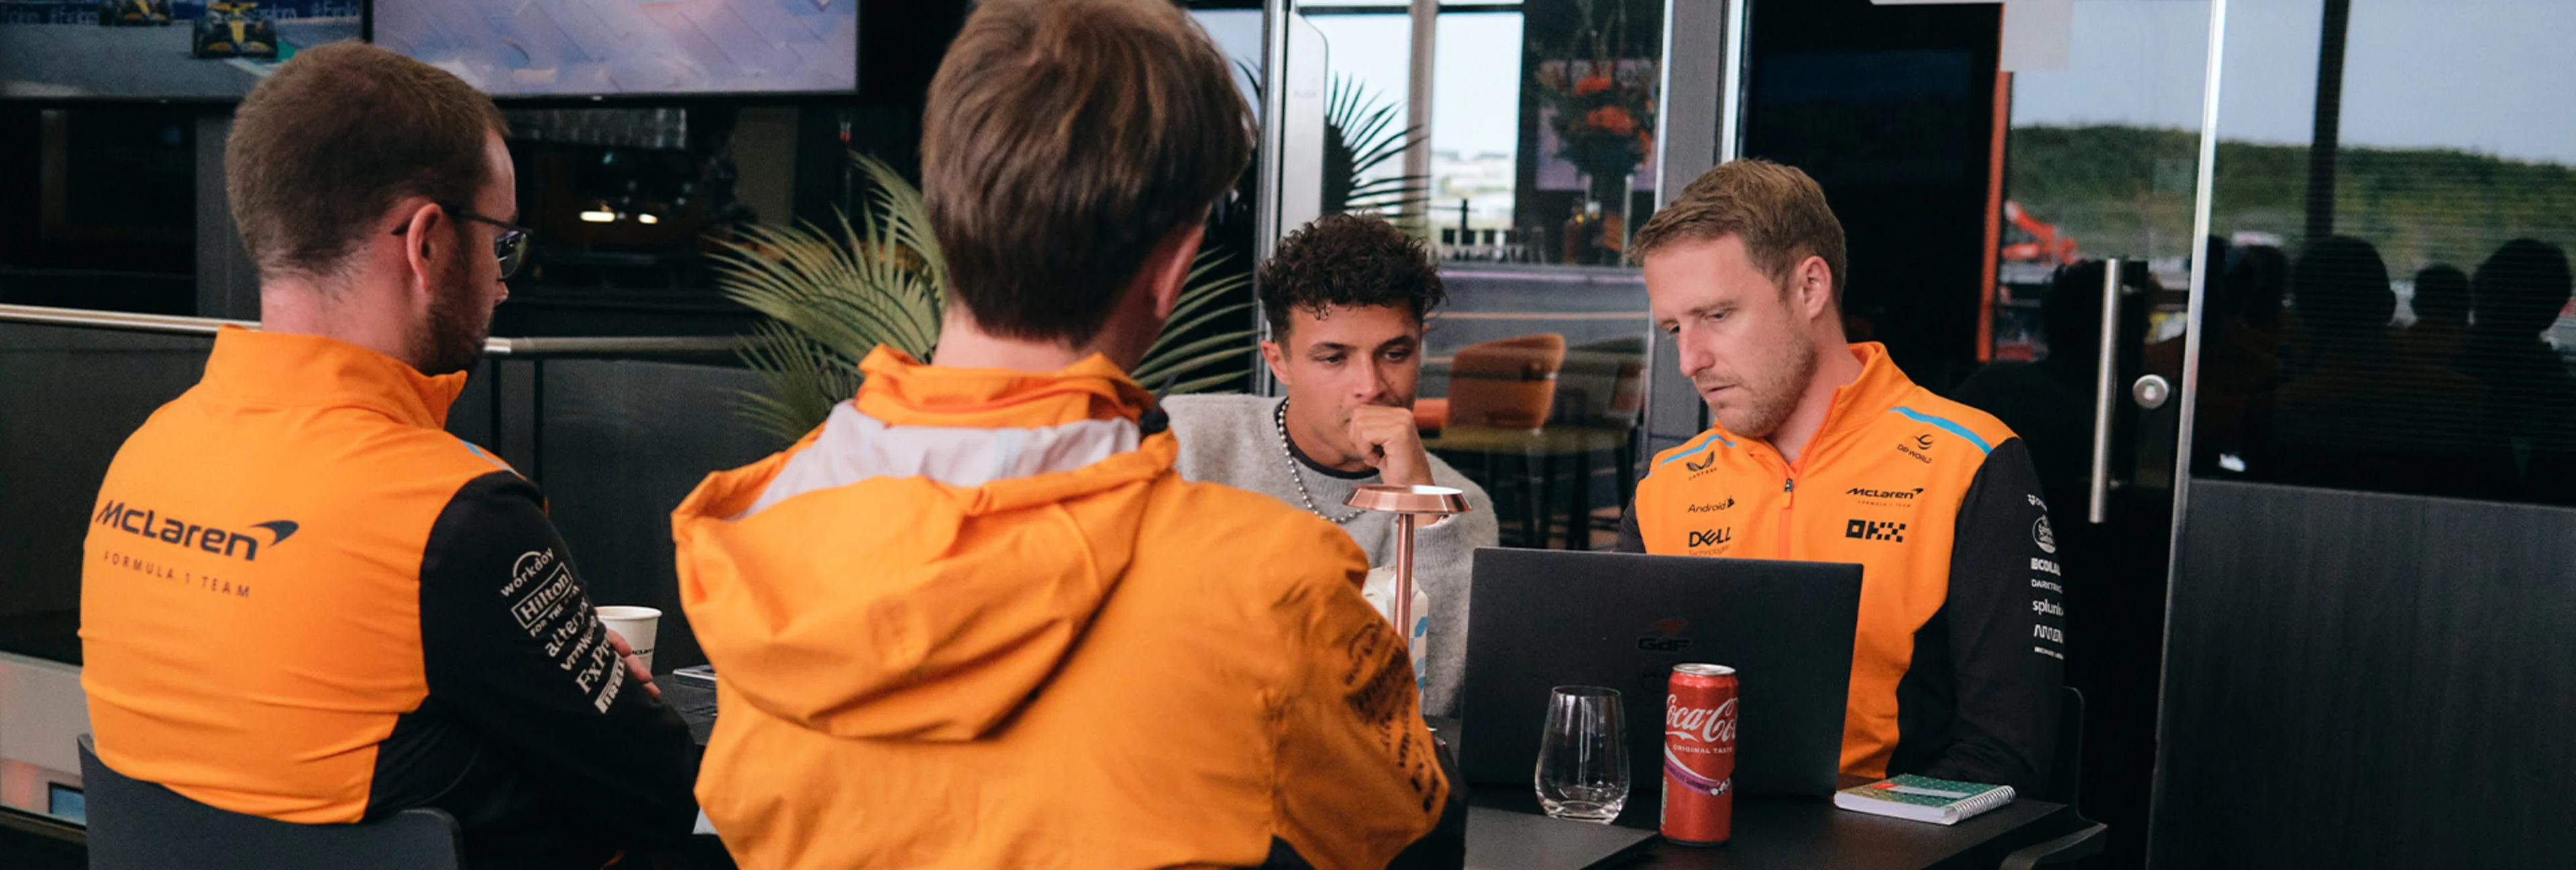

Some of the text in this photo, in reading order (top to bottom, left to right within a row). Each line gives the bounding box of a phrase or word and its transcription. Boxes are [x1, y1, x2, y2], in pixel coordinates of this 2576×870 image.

[1896, 443, 1933, 464] DP WORLD
[1687, 500, 1727, 513] Android
[1845, 487, 1914, 499] McLaren
[95, 499, 258, 561] McLaren
[1688, 526, 1731, 548] DELL
[1845, 519, 1906, 543] OKX
[103, 550, 251, 598] FORMULA 1 TEAM
[500, 547, 554, 596] workday
[520, 574, 570, 621] Hilton
[530, 604, 564, 637] FOR THE
[1666, 694, 1738, 743] Coca-Col
[1672, 743, 1710, 754] ORIGINAL
